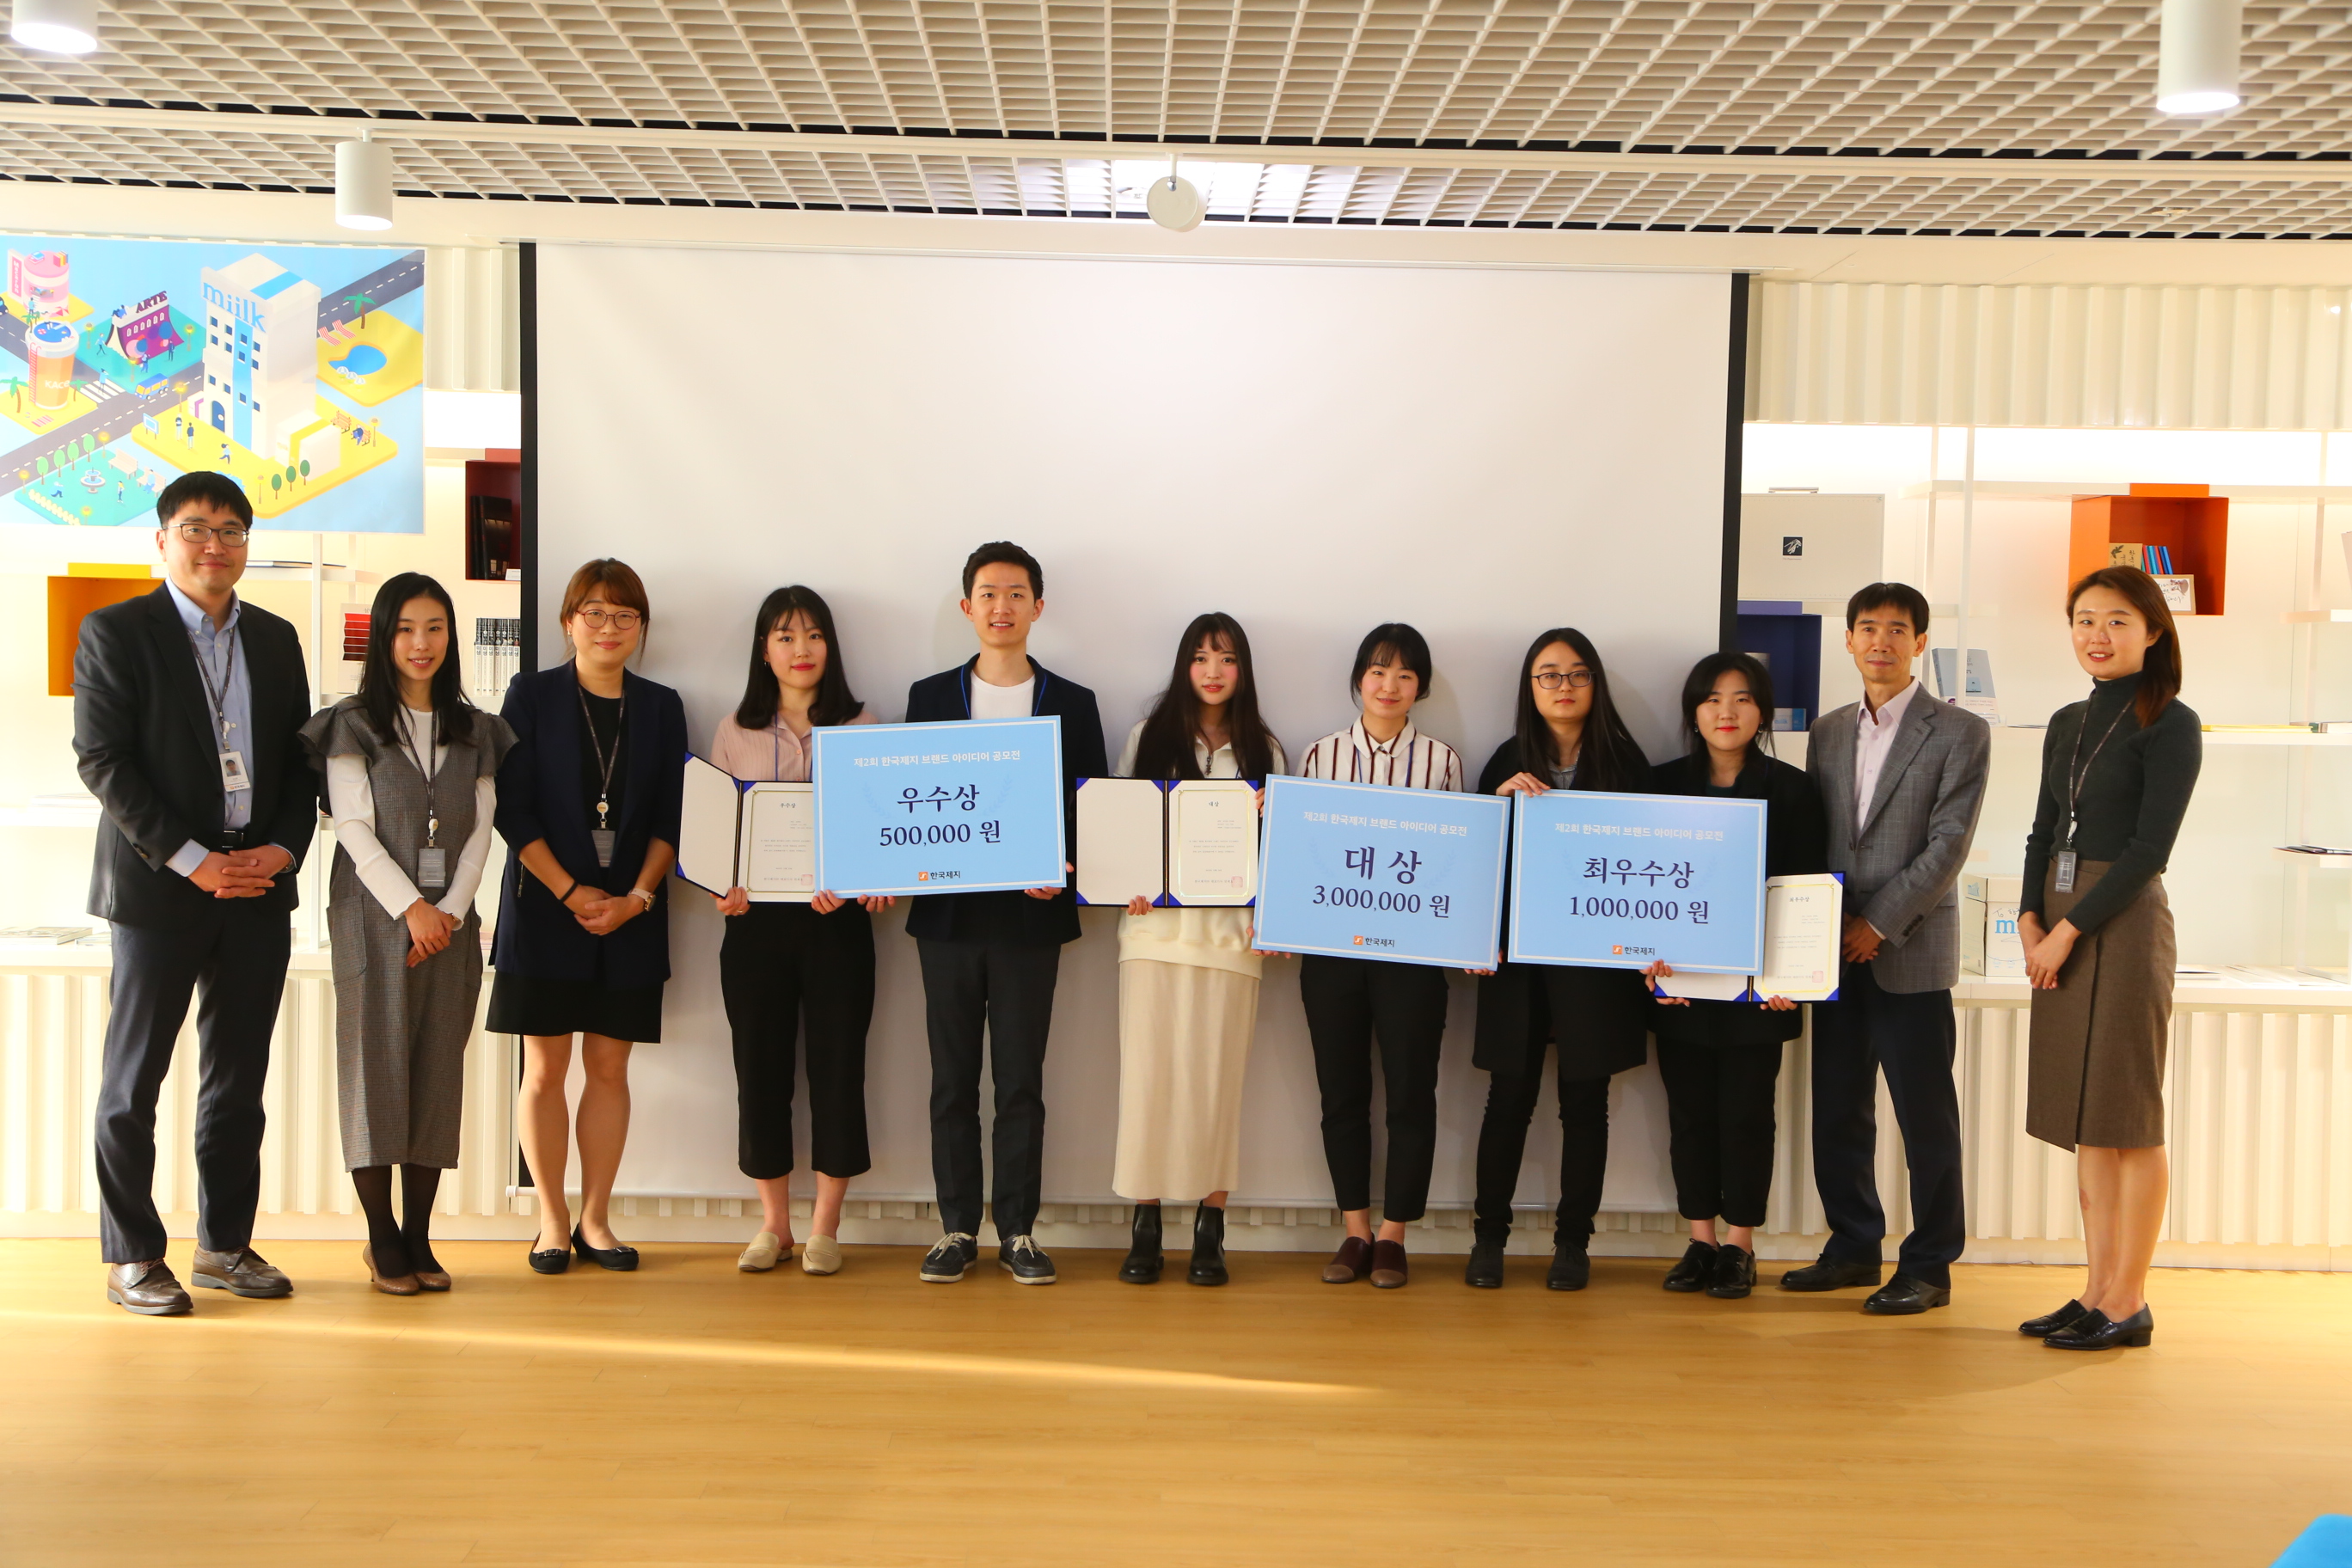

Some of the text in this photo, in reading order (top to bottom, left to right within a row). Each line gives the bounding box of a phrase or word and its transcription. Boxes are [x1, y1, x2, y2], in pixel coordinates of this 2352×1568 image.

[136, 291, 168, 314] ARTE
[203, 282, 266, 333] miilk
[854, 750, 1021, 768] 제2회 한국제지 브랜드 아이디어 공모전
[897, 783, 980, 814] 우수상
[879, 820, 1001, 847] 500,000 원
[1303, 811, 1467, 836] 제2회 한국제지 브랜드 아이디어 공모전
[1555, 823, 1724, 842] 제2회 한국제지 브랜드 아이디어 공모전
[930, 870, 961, 880] 한국제지
[1583, 857, 1695, 889] 최우수상
[1313, 885, 1450, 919] 3,000,000 원
[1570, 896, 1709, 925] 1,000,000 원
[1365, 936, 1396, 948] 한국제지
[1624, 946, 1656, 956] 한국제지
